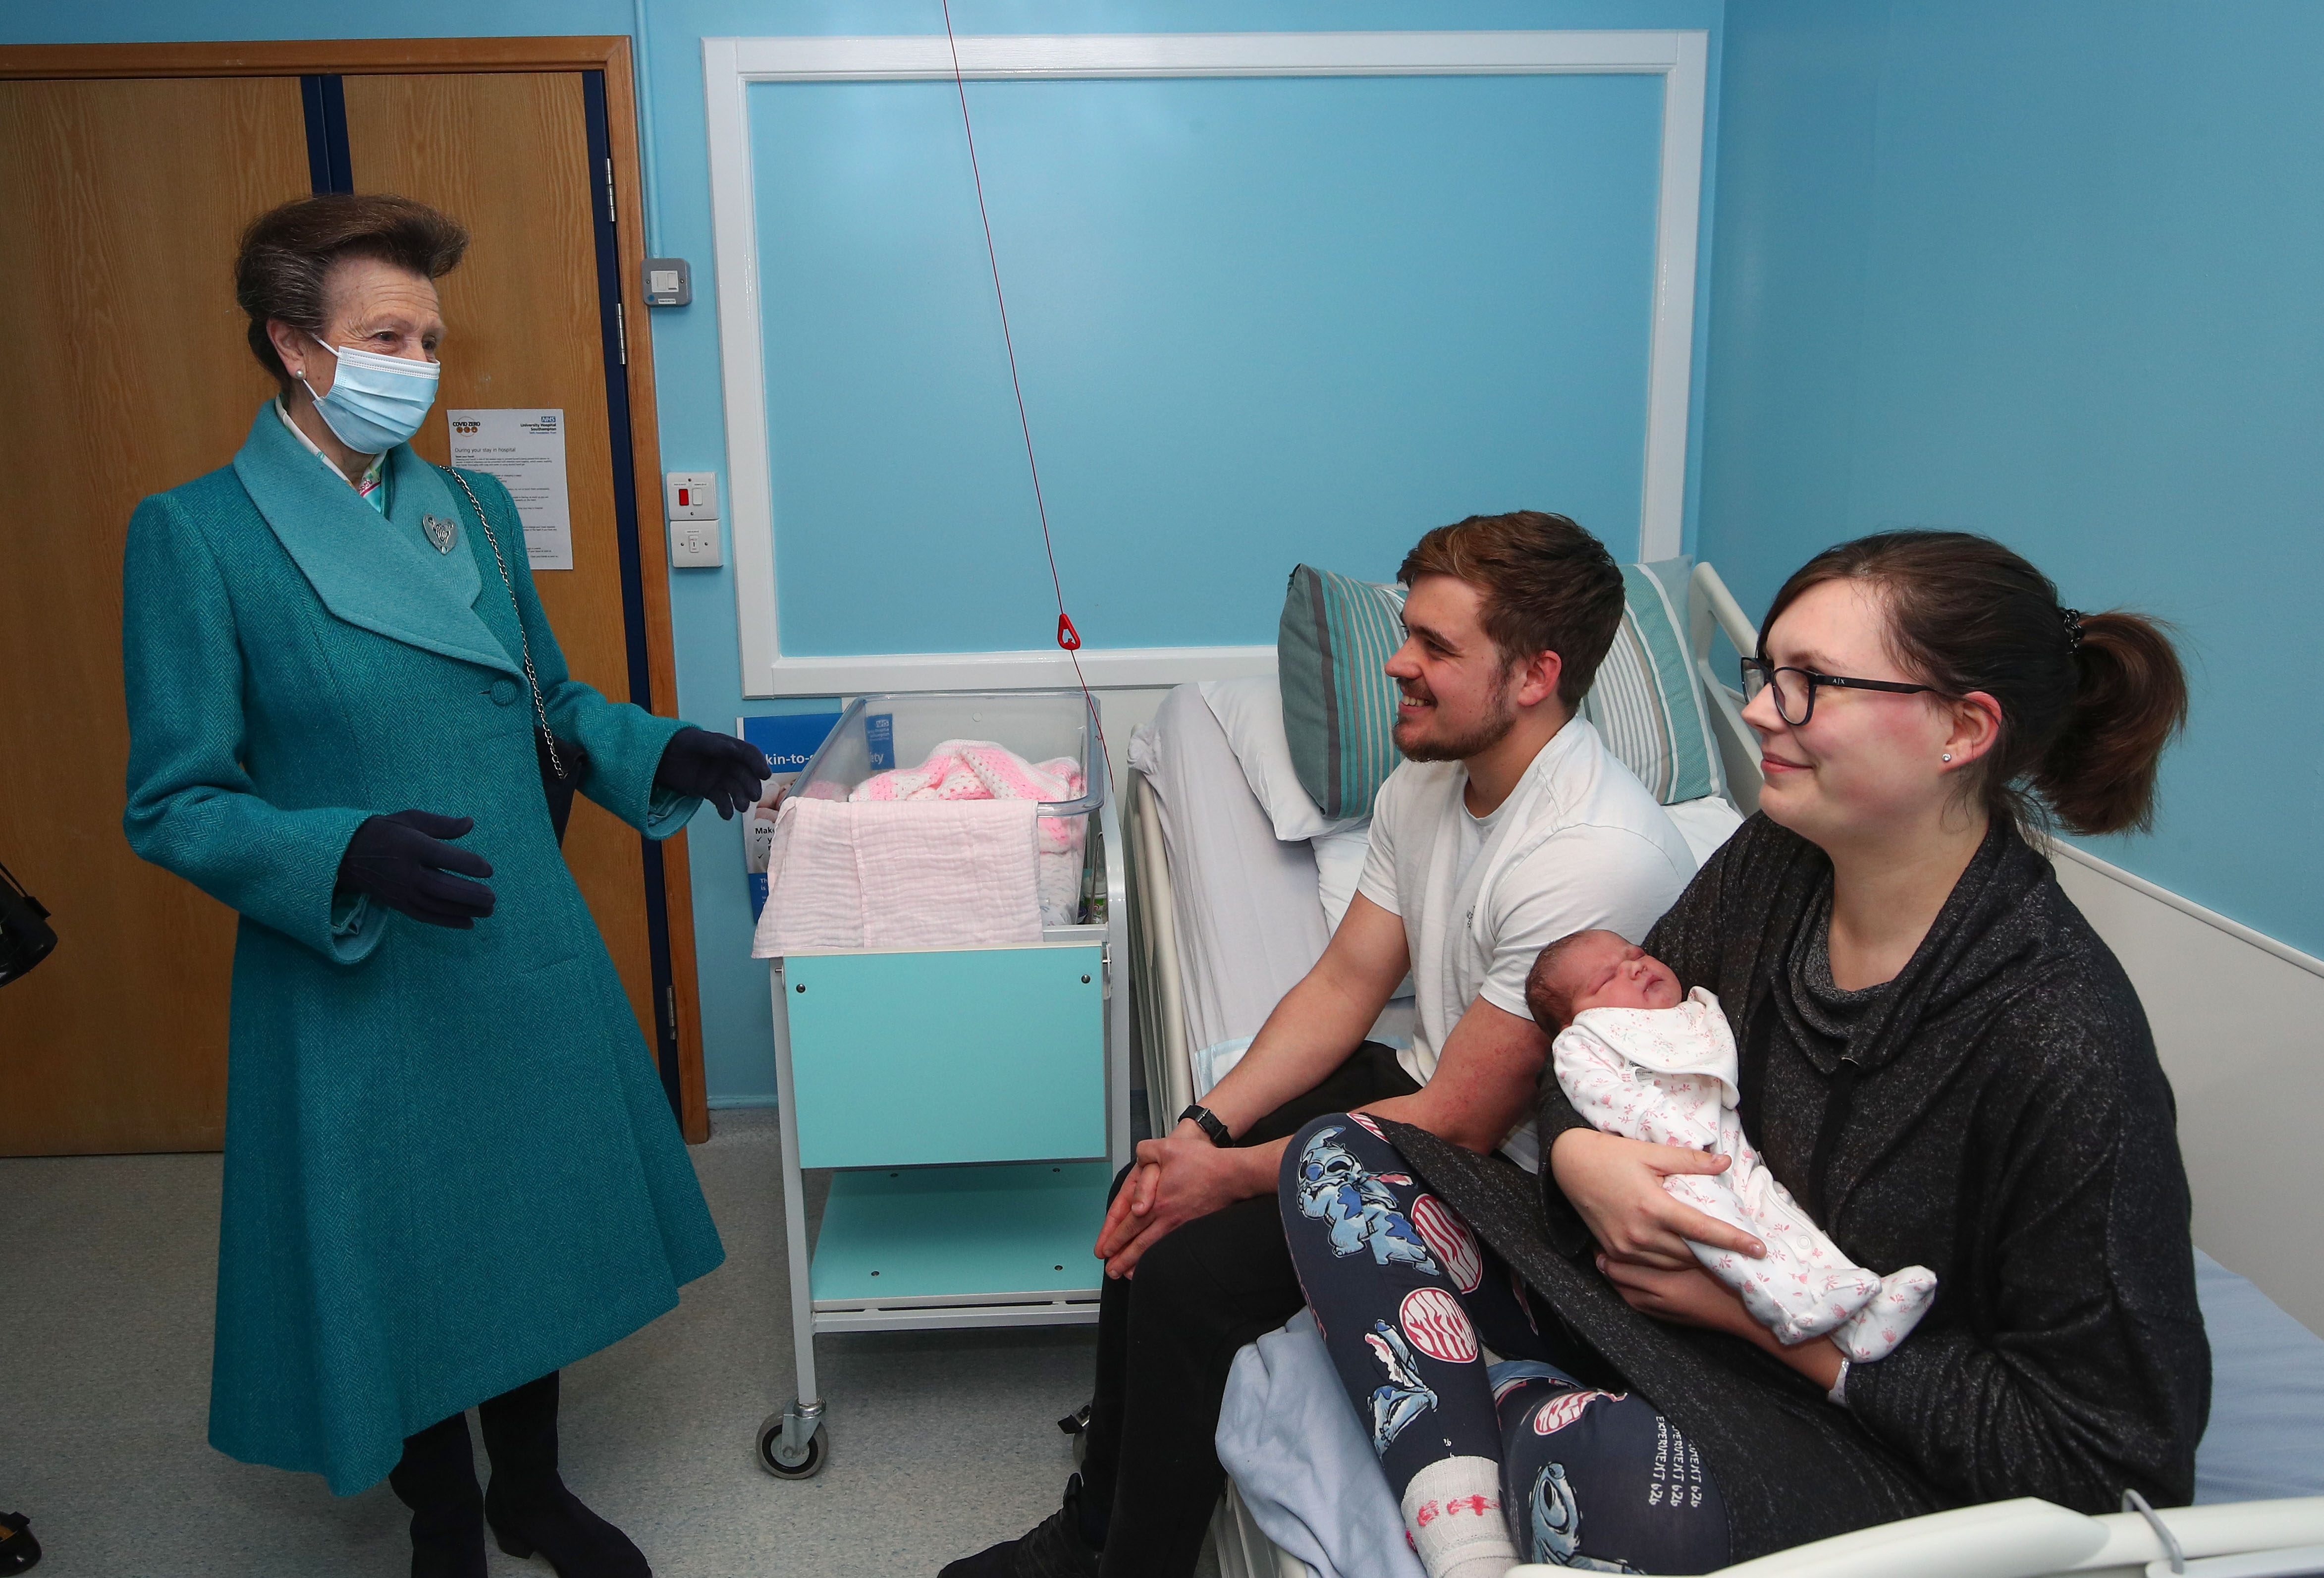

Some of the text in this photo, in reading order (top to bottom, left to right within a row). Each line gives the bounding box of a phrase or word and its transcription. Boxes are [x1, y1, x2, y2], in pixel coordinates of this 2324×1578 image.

[765, 754, 813, 765] kin-to-
[1649, 1416, 1668, 1506] EXPERIMENT 626
[1670, 1484, 1684, 1507] 626
[1690, 1485, 1702, 1508] 626
